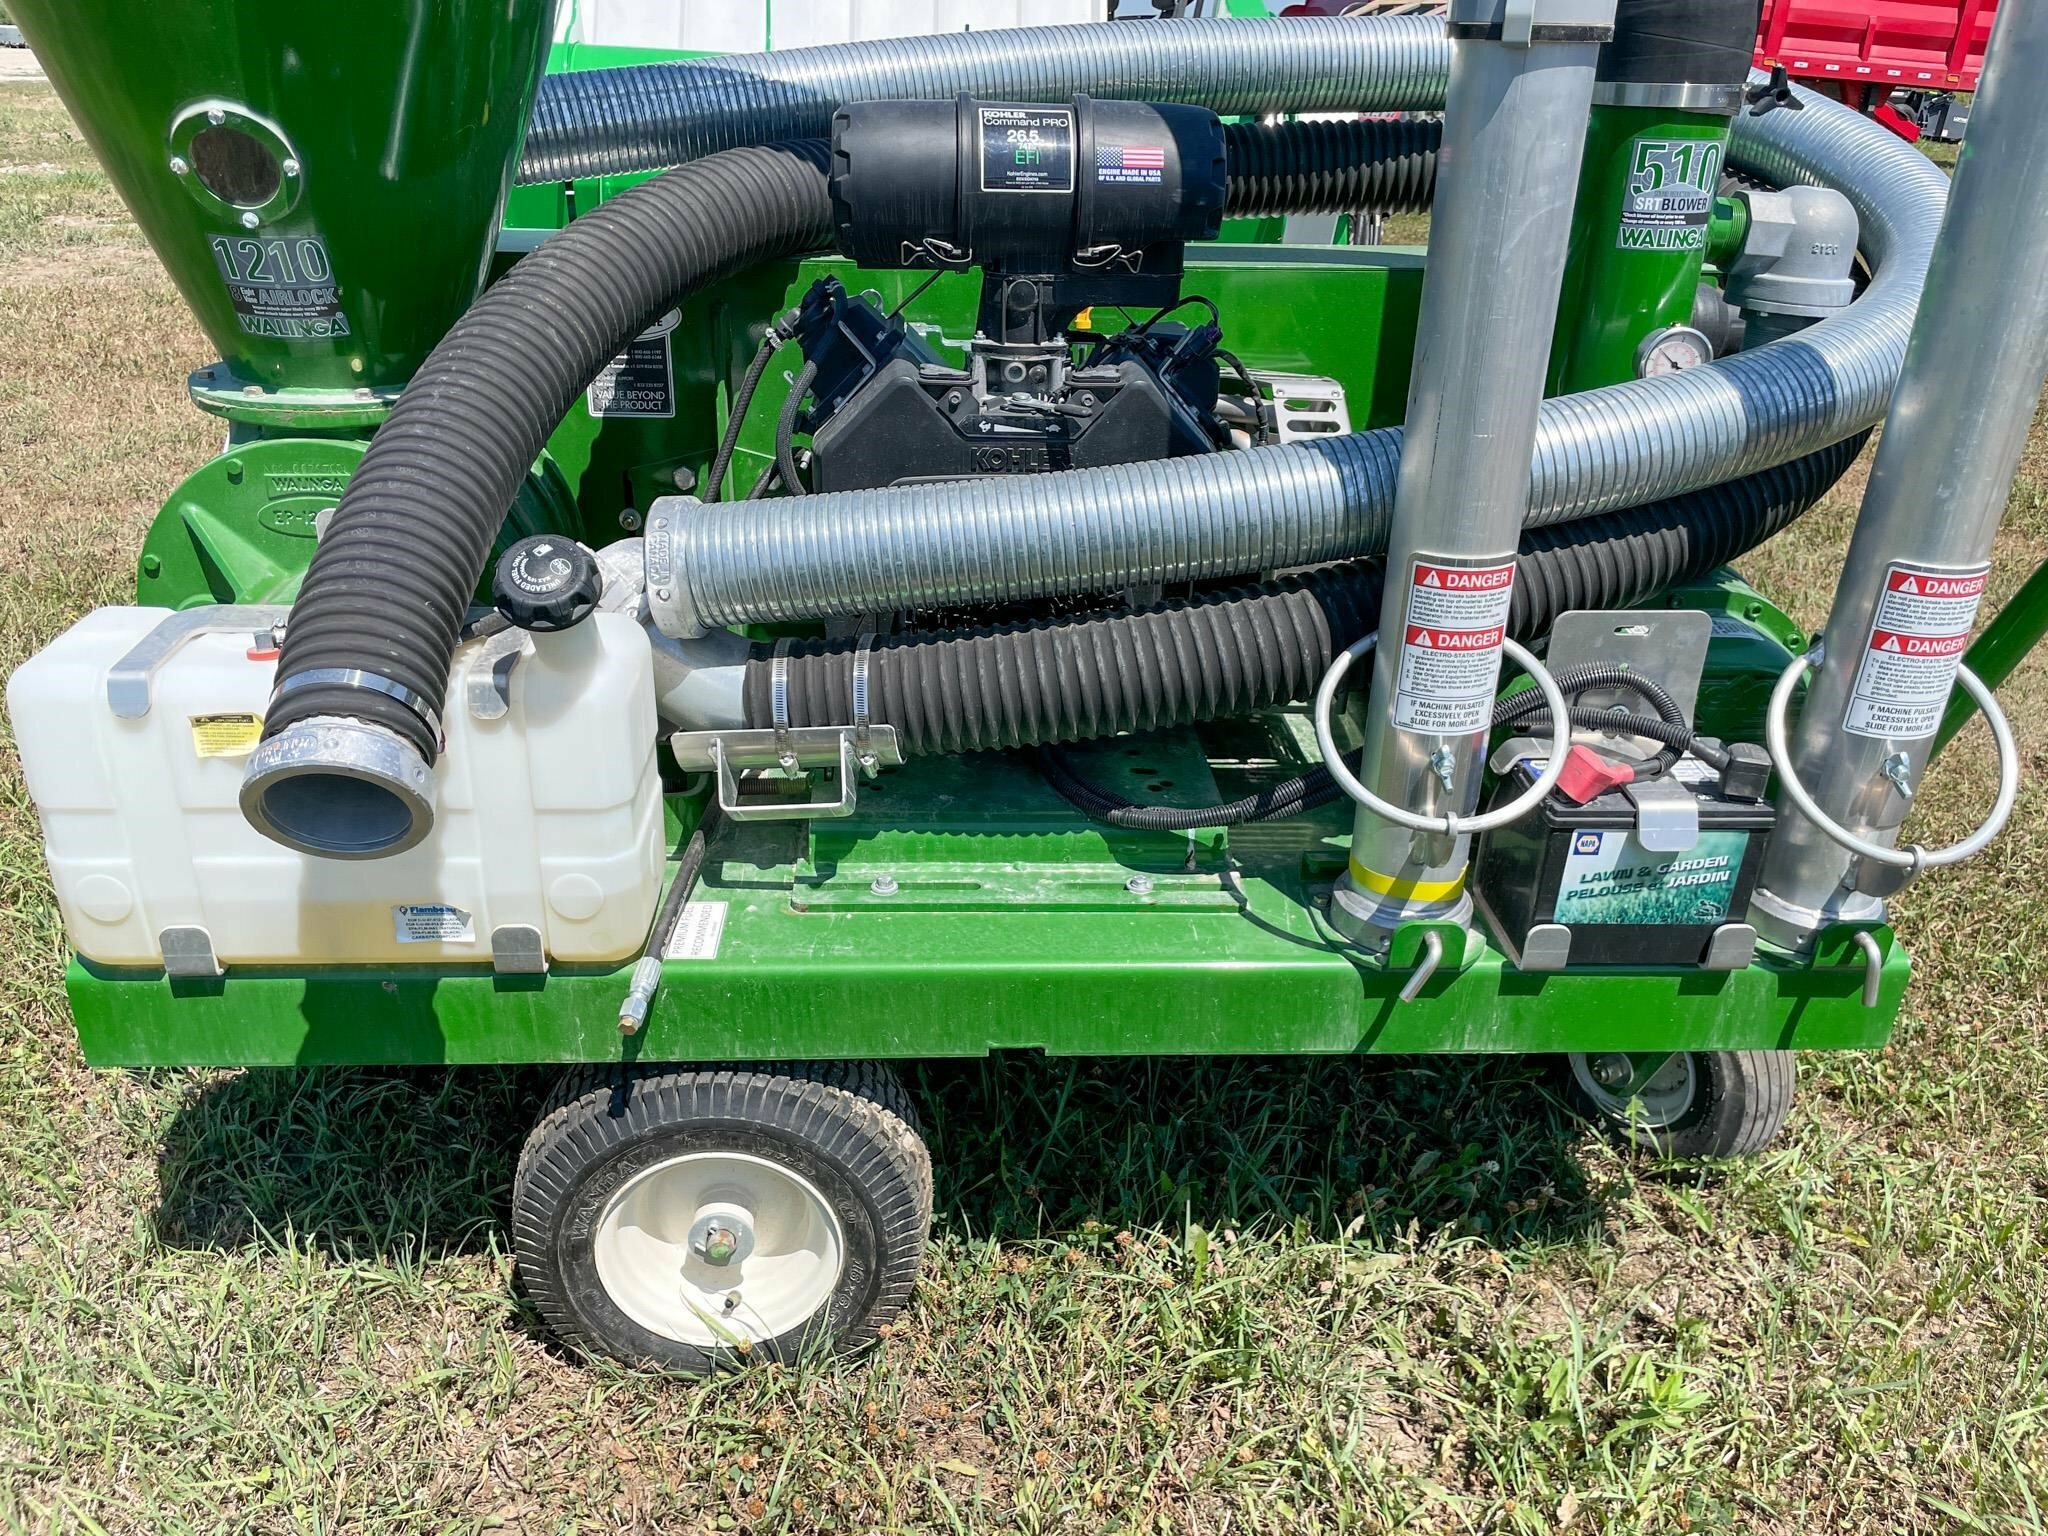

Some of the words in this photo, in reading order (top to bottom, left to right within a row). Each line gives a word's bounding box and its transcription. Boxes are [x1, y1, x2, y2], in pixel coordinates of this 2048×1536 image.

[983, 110, 1026, 119] KOHLER
[983, 117, 1040, 127] Command
[1042, 118, 1068, 127] PRO
[1006, 129, 1040, 142] 26.5
[1015, 149, 1040, 165] EFI
[1630, 141, 1720, 197] 510
[1619, 226, 1704, 249] WALINGA
[212, 237, 330, 283] 1210
[259, 287, 338, 306] AIRLOCK
[237, 314, 350, 338] WALINGA
[597, 390, 625, 400] VALUE
[626, 390, 665, 400] BEYOND
[602, 400, 618, 409] THE
[620, 401, 662, 410] PRODUCT
[271, 477, 345, 492] WALINGA
[512, 551, 527, 567] ONLY
[648, 535, 660, 580] CANADA
[511, 567, 523, 585] FUEL
[1446, 571, 1509, 588] DANGER
[520, 578, 561, 592] UNLEADED
[1924, 578, 1983, 595] DANGER
[1437, 630, 1499, 648] DANGER
[1906, 637, 1964, 653] DANGER
[1422, 649, 1475, 659] ELECTRO-STATIC
[1887, 655, 1941, 665] ELECTRO-STATIC
[1418, 701, 1453, 711] MACHINE
[1453, 699, 1485, 711] PULSATES
[1867, 703, 1877, 712] IF
[1877, 705, 1912, 716] MACHINE
[1913, 704, 1941, 716] PULSATES
[1409, 716, 1430, 727] SLIDE
[1431, 718, 1447, 728] FOR
[1450, 718, 1468, 728] MORE
[1414, 708, 1461, 720] EXCESSIVELY,
[1462, 710, 1480, 719] OPEN
[1920, 714, 1935, 723] OPEN
[1864, 721, 1887, 732] SLIDE
[1888, 723, 1904, 732] FOR
[1904, 723, 1923, 732] MORE
[1580, 838, 1597, 848] NAPA
[1579, 867, 1633, 884] LAWN
[1637, 866, 1651, 878] &
[1656, 855, 1729, 875] GARDEN
[1566, 881, 1645, 901] PELOUSE
[1647, 881, 1665, 890] et
[1666, 870, 1731, 888] JARDIN
[409, 905, 456, 915] Flambeau
[672, 922, 689, 955] PREMIUM
[681, 905, 695, 921] FUEL
[690, 904, 713, 956] RECOMMENDED
[570, 1159, 639, 1241] WANDA
